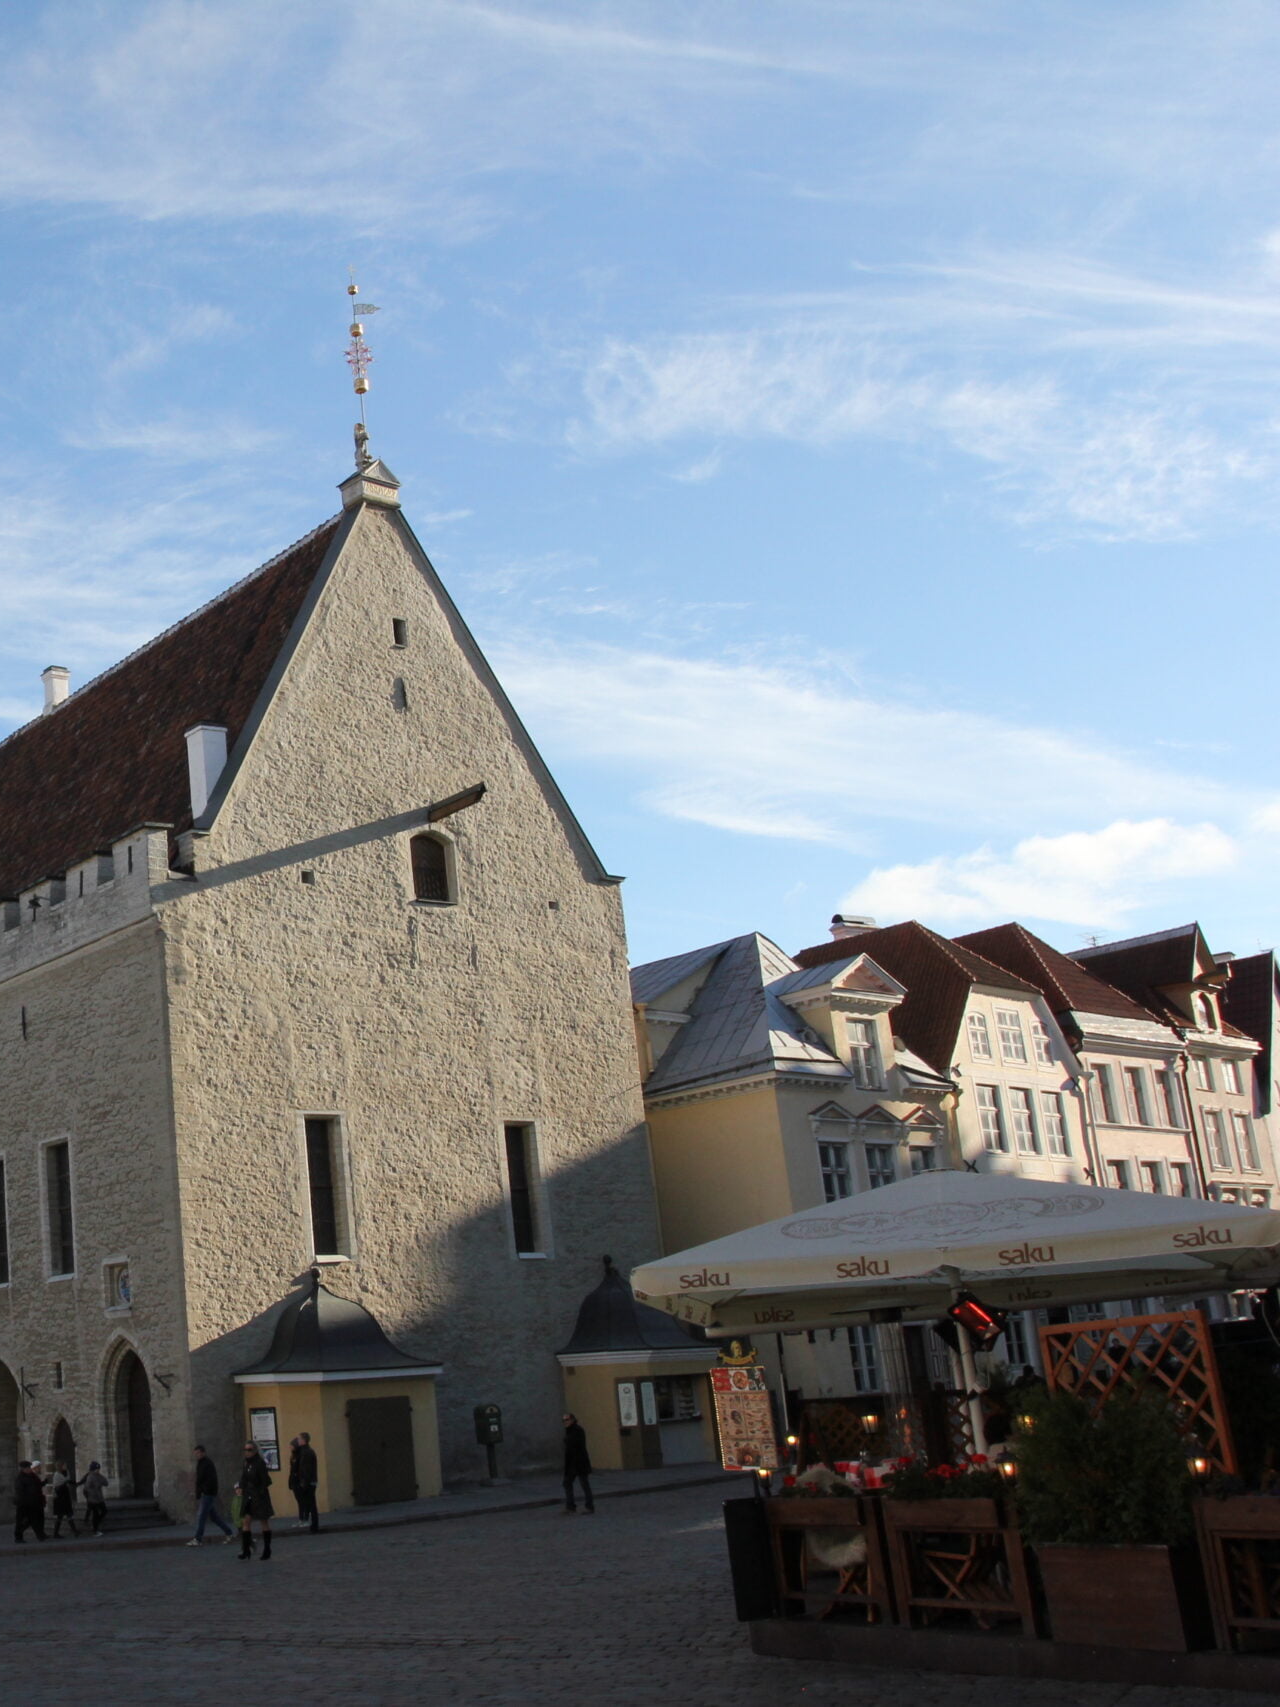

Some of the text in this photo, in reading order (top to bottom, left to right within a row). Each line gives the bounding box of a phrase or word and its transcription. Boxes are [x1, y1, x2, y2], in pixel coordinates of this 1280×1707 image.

[1173, 1225, 1233, 1248] saku
[998, 1242, 1055, 1266] saku
[679, 1269, 731, 1289] saku
[836, 1256, 890, 1279] saku
